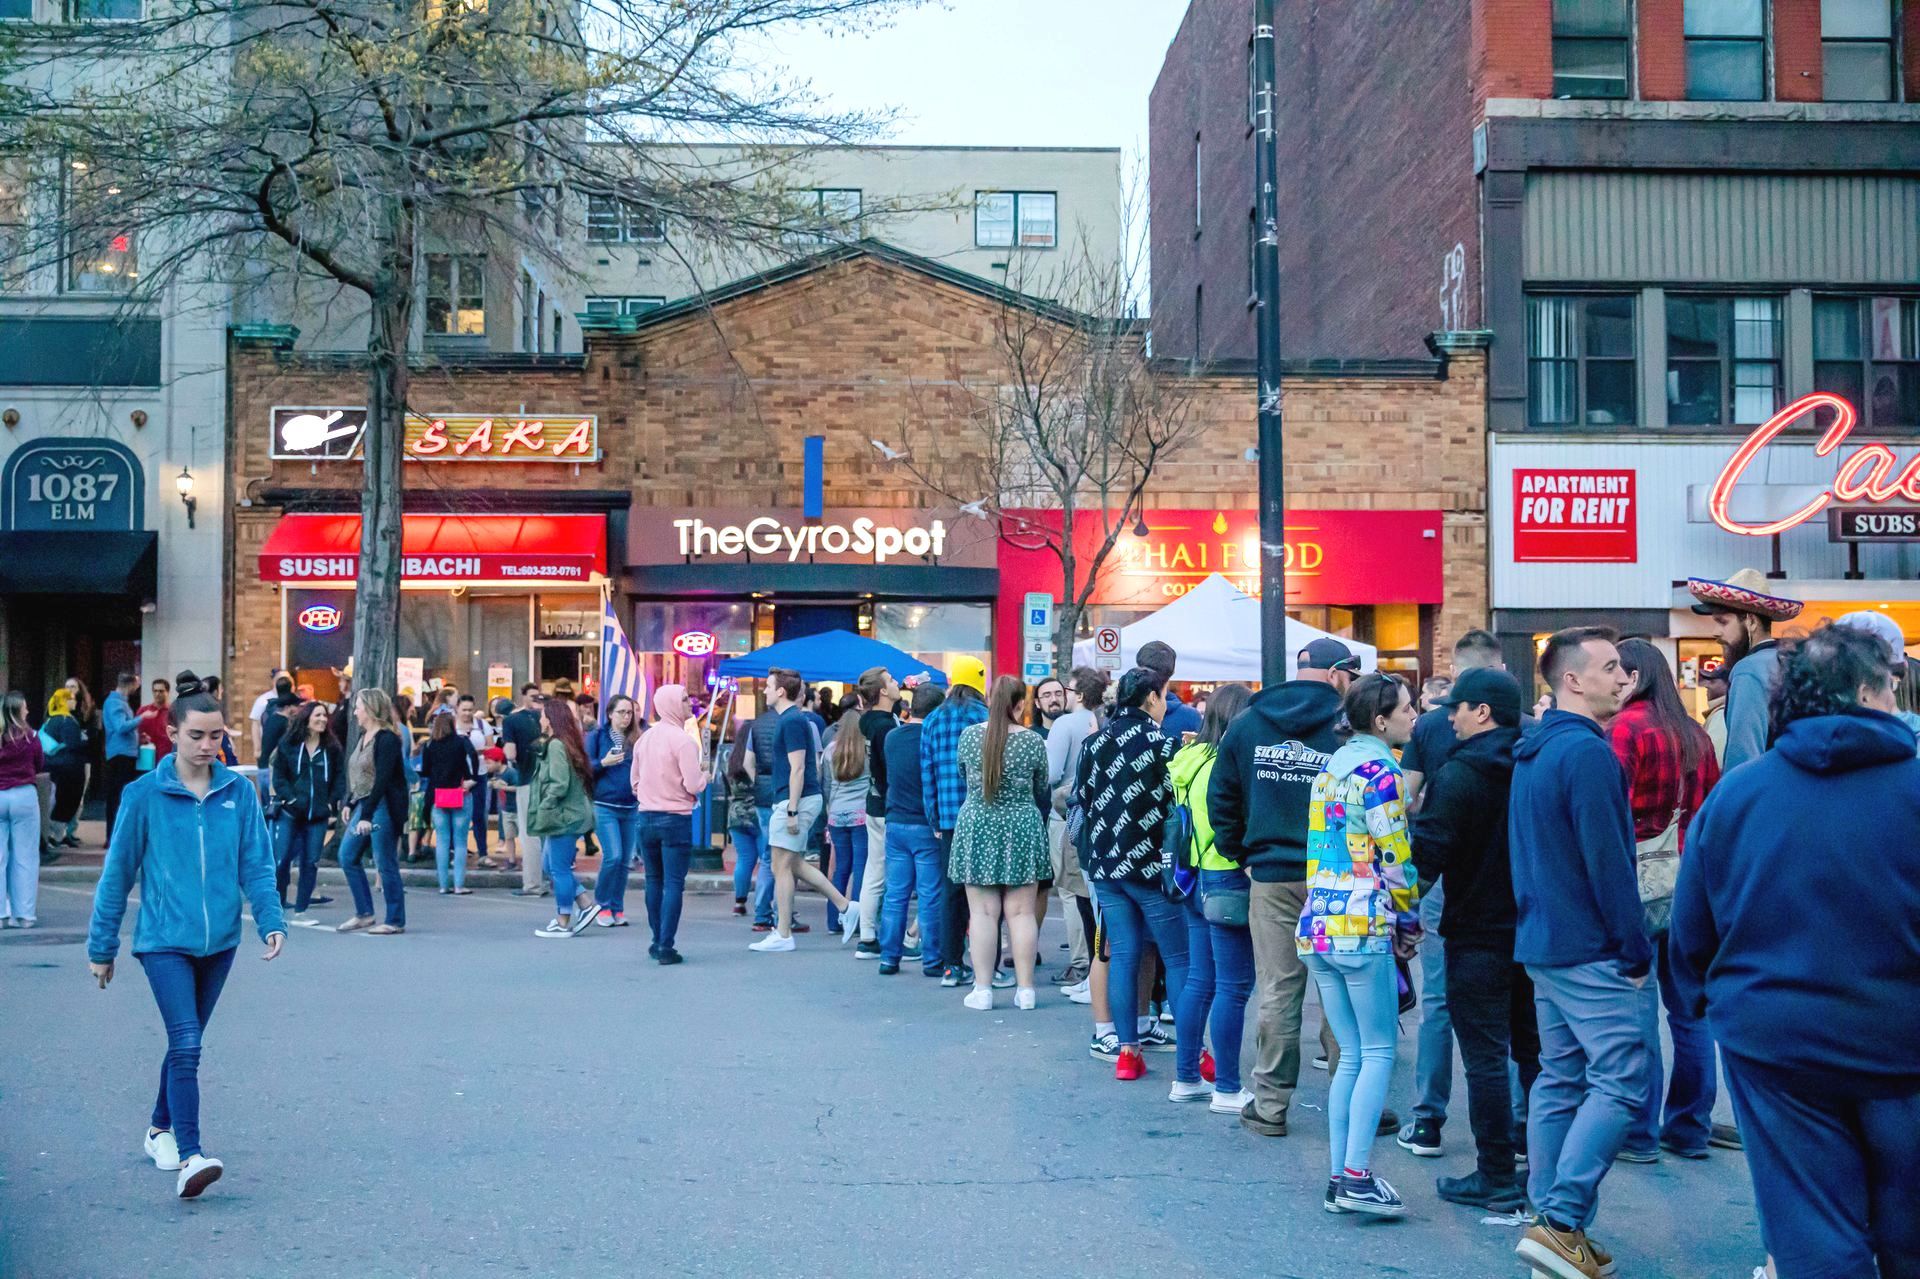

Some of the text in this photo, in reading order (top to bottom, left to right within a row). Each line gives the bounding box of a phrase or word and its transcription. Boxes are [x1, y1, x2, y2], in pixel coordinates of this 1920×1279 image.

[412, 419, 590, 456] SAKA
[28, 473, 119, 502] 1087
[1521, 475, 1629, 494] APARTMENT
[51, 503, 95, 520] ELM
[1520, 497, 1630, 524] FOR RENT
[1855, 514, 1916, 533] SUBS
[673, 516, 947, 562] TheGyroSpot
[1124, 541, 1207, 569] HAI
[278, 557, 582, 577] SUSHI IBACHI TEL:603-232-0761
[299, 610, 341, 627] OPEN
[547, 623, 584, 636] 1077
[673, 632, 716, 654] OPEN
[1115, 724, 1142, 747] DKNY
[1130, 749, 1155, 773] DKNY
[1254, 745, 1296, 761] SILVA'S
[1105, 752, 1127, 780] DKNY
[1256, 769, 1279, 782] (603)
[1094, 783, 1116, 811] DKNY
[1121, 778, 1147, 804] DKNY
[1090, 816, 1108, 844] DKNY
[1112, 809, 1132, 837] DKNY
[1137, 806, 1163, 832] DKNY
[1126, 836, 1154, 859] DKNY
[1110, 857, 1134, 879] DKNY
